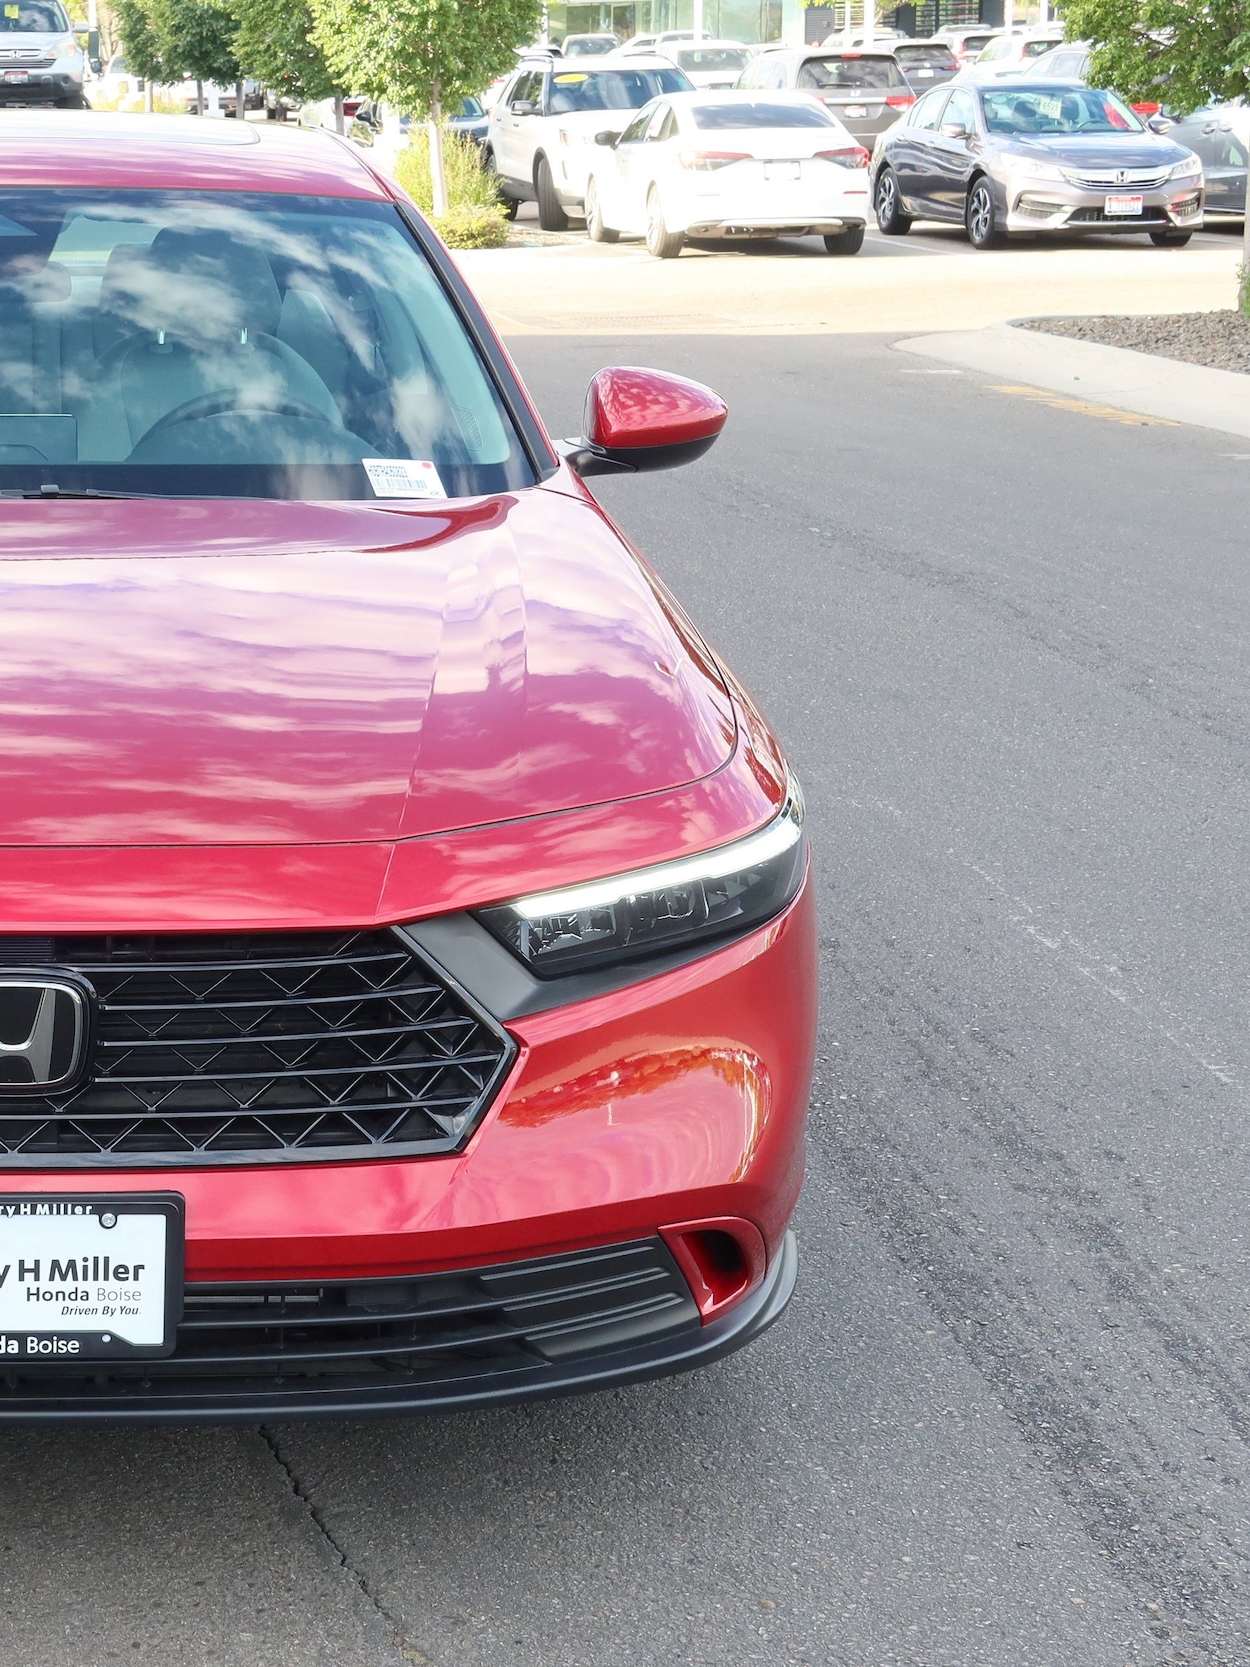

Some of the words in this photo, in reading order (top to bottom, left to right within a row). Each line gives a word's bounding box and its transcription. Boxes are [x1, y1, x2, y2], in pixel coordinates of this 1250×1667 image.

[1042, 102, 1059, 112] 6525
[20, 1203, 31, 1215] H
[35, 1203, 93, 1215] Miller
[18, 1259, 39, 1282] H
[48, 1256, 146, 1282] Miller
[26, 1286, 89, 1302] Honda
[96, 1286, 142, 1302] Boise
[61, 1305, 98, 1316] Driven
[101, 1305, 117, 1317] By
[25, 1335, 80, 1355] Boise
